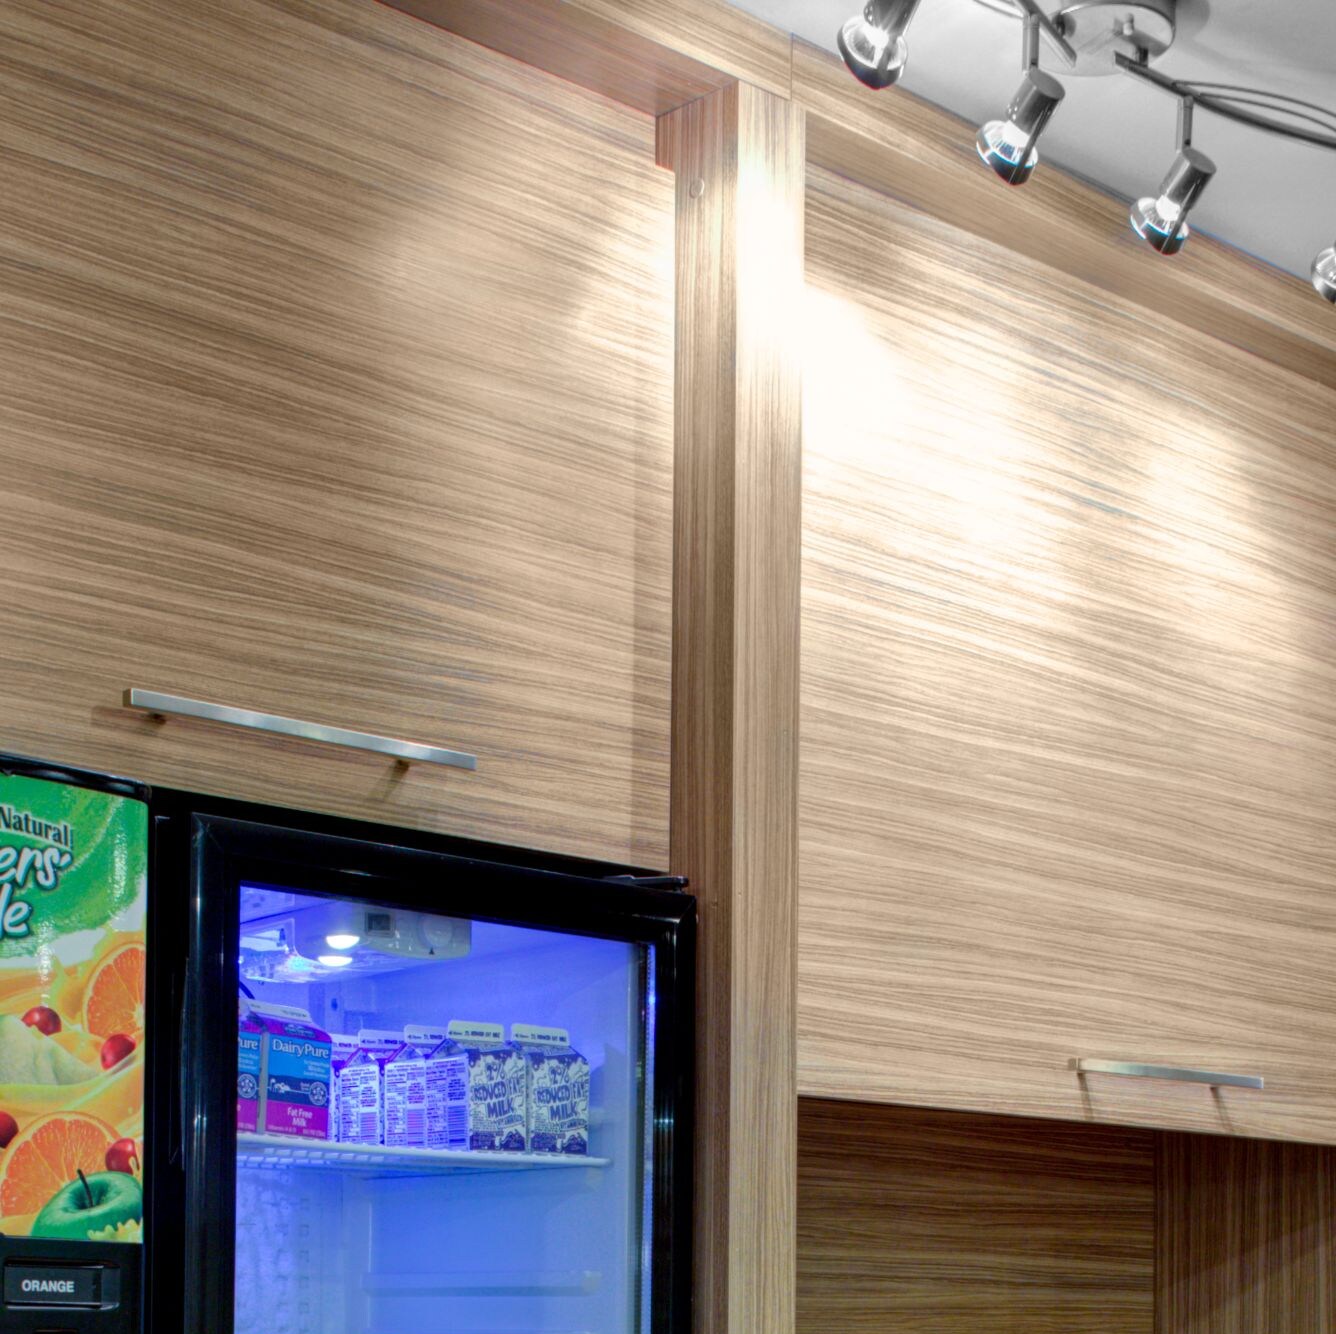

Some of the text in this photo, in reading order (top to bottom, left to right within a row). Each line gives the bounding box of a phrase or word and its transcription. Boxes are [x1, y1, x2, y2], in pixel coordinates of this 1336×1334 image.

[487, 1098, 515, 1119] MILK
[550, 1102, 578, 1122] MILK
[21, 1279, 75, 1293] ORANGE
